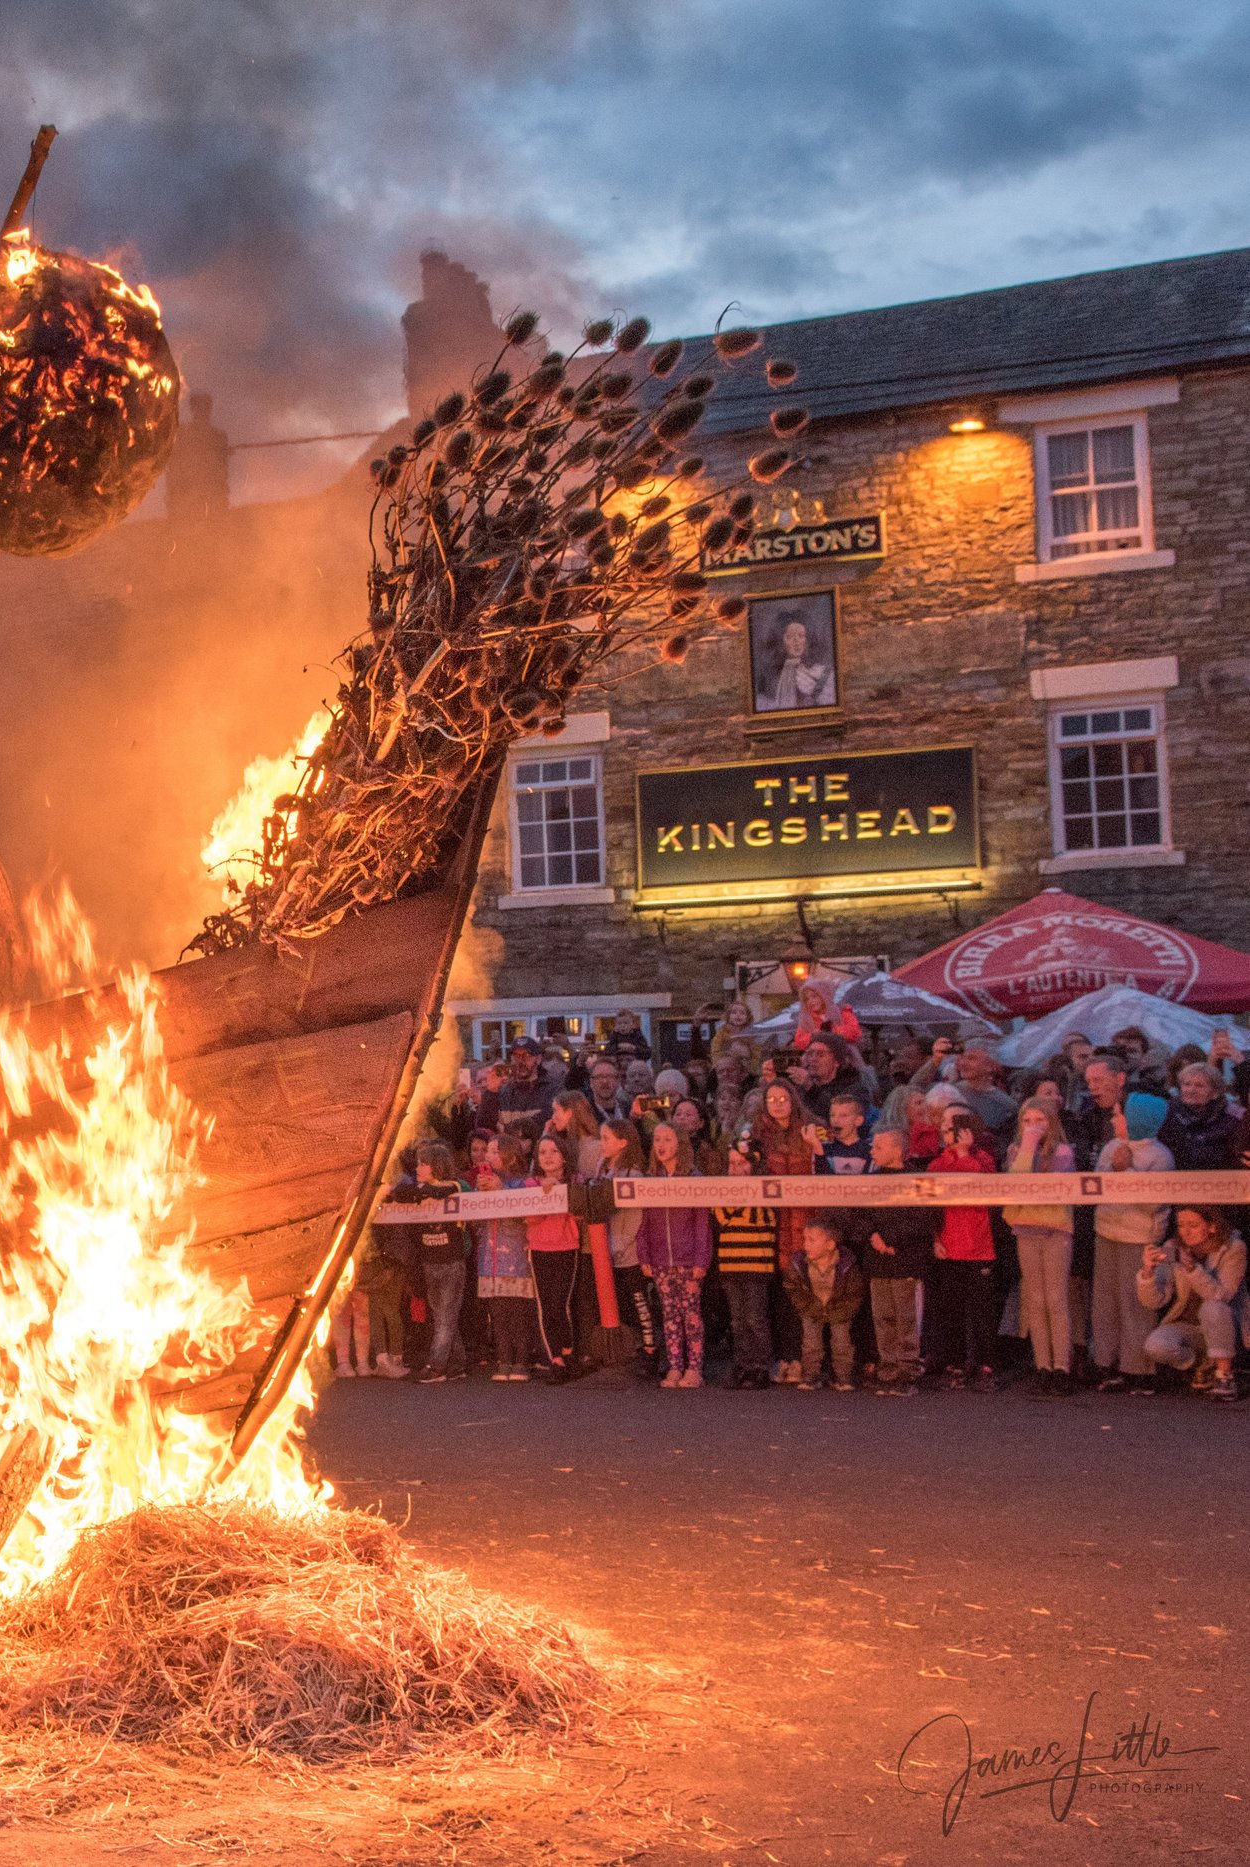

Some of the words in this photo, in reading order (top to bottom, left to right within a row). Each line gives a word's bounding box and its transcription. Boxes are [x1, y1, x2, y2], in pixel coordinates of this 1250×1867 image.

[754, 773, 849, 806] THE
[955, 926, 1037, 978] BIRRA
[1041, 914, 1187, 965] MORETTI
[461, 1191, 565, 1211] RedHotproperty
[637, 1184, 759, 1200] RedHotproperty
